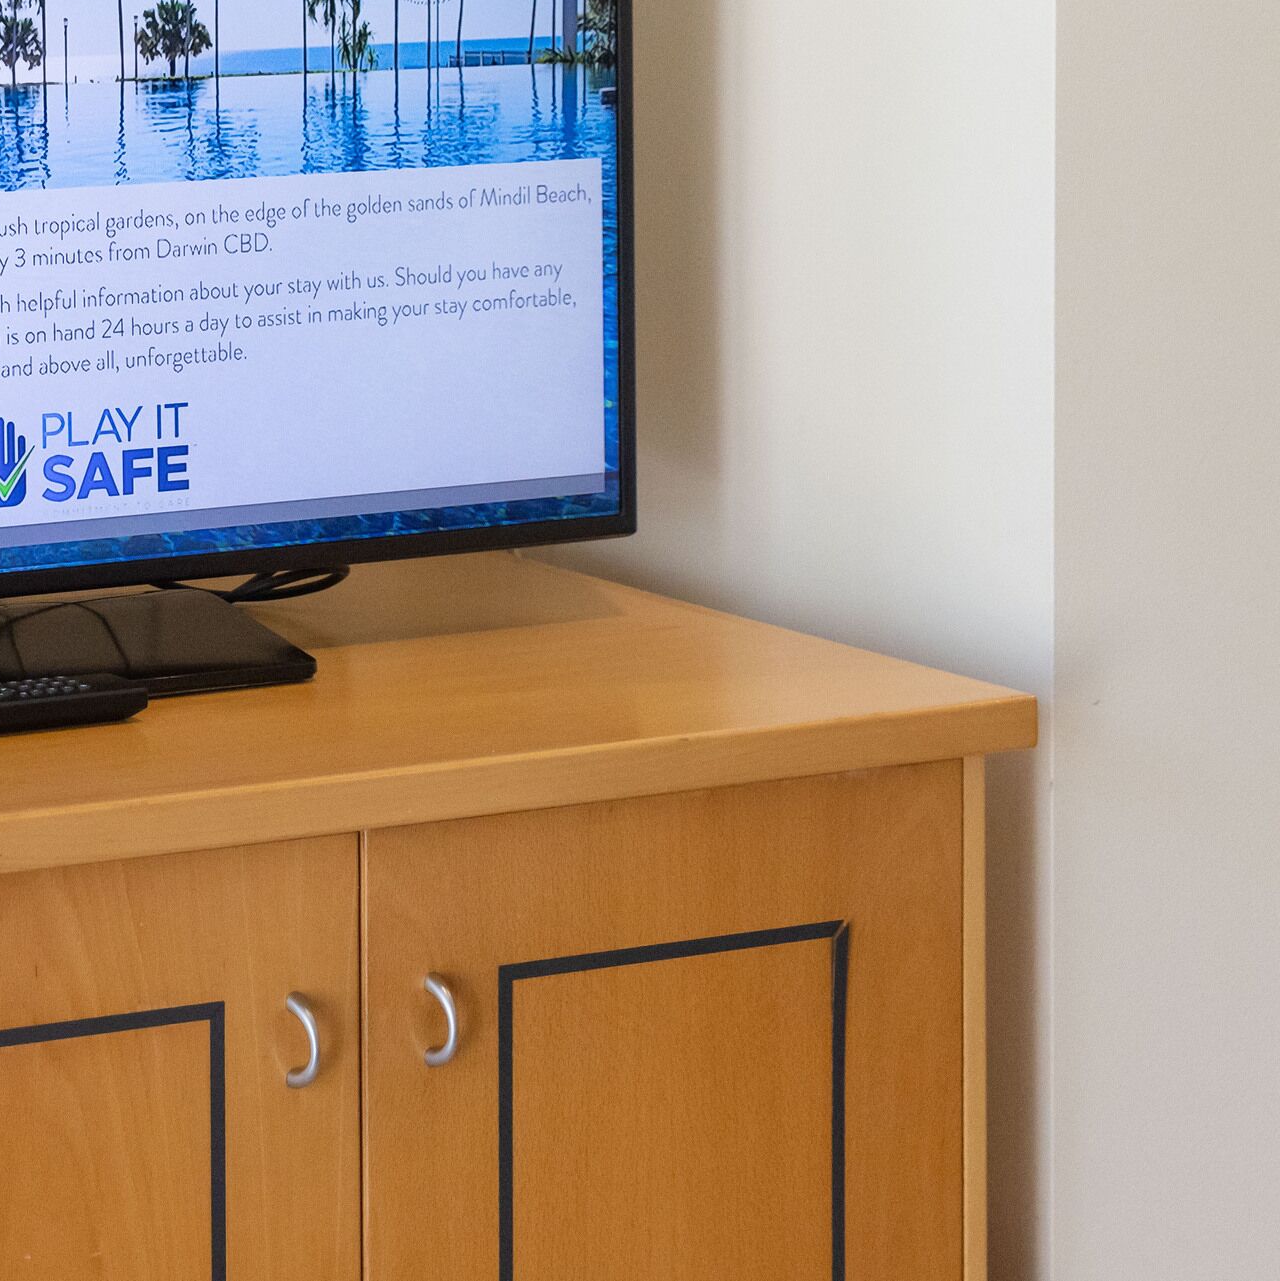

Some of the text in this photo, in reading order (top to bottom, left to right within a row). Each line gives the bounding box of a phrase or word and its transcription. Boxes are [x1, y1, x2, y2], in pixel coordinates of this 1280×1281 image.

[34, 211, 100, 241] tropical
[105, 208, 179, 239] gardens,
[184, 211, 206, 226] on
[212, 203, 240, 225] the
[244, 200, 286, 229] edge
[291, 197, 311, 220] of
[314, 197, 342, 218] the
[346, 194, 402, 224] golden
[407, 191, 454, 213] sands
[458, 188, 477, 209] of
[479, 185, 531, 207] Mindil
[536, 182, 592, 204] Beach,
[14, 247, 26, 268] 3
[32, 246, 103, 267] minutes
[108, 240, 150, 262] from
[156, 236, 218, 259] Darwin
[223, 232, 273, 255] CBD.
[6, 326, 20, 346] is
[24, 330, 47, 345] on
[53, 319, 95, 342] hand
[101, 317, 125, 339] 24
[131, 316, 180, 337] hours
[184, 320, 194, 333] a
[199, 311, 230, 338] day
[235, 313, 253, 329] to
[257, 306, 302, 328] assist
[308, 304, 322, 324] in
[328, 300, 388, 327] making
[391, 303, 430, 325] your
[434, 299, 468, 321] stay
[472, 287, 577, 312] comfortable,
[16, 288, 77, 319] helpful
[82, 284, 184, 308] information
[189, 280, 239, 301] about
[243, 281, 283, 305] your
[287, 278, 322, 300] stay
[326, 270, 362, 291] with
[366, 275, 390, 290] us.
[394, 263, 452, 287] Should
[456, 269, 487, 290] you
[492, 262, 530, 280] have
[534, 263, 563, 283] any
[0, 355, 33, 379] and
[38, 354, 91, 376] above
[96, 349, 120, 373] all,
[125, 341, 248, 374] unforgettable.
[41, 401, 189, 450] PLAY IT
[41, 444, 190, 503] SAFE
